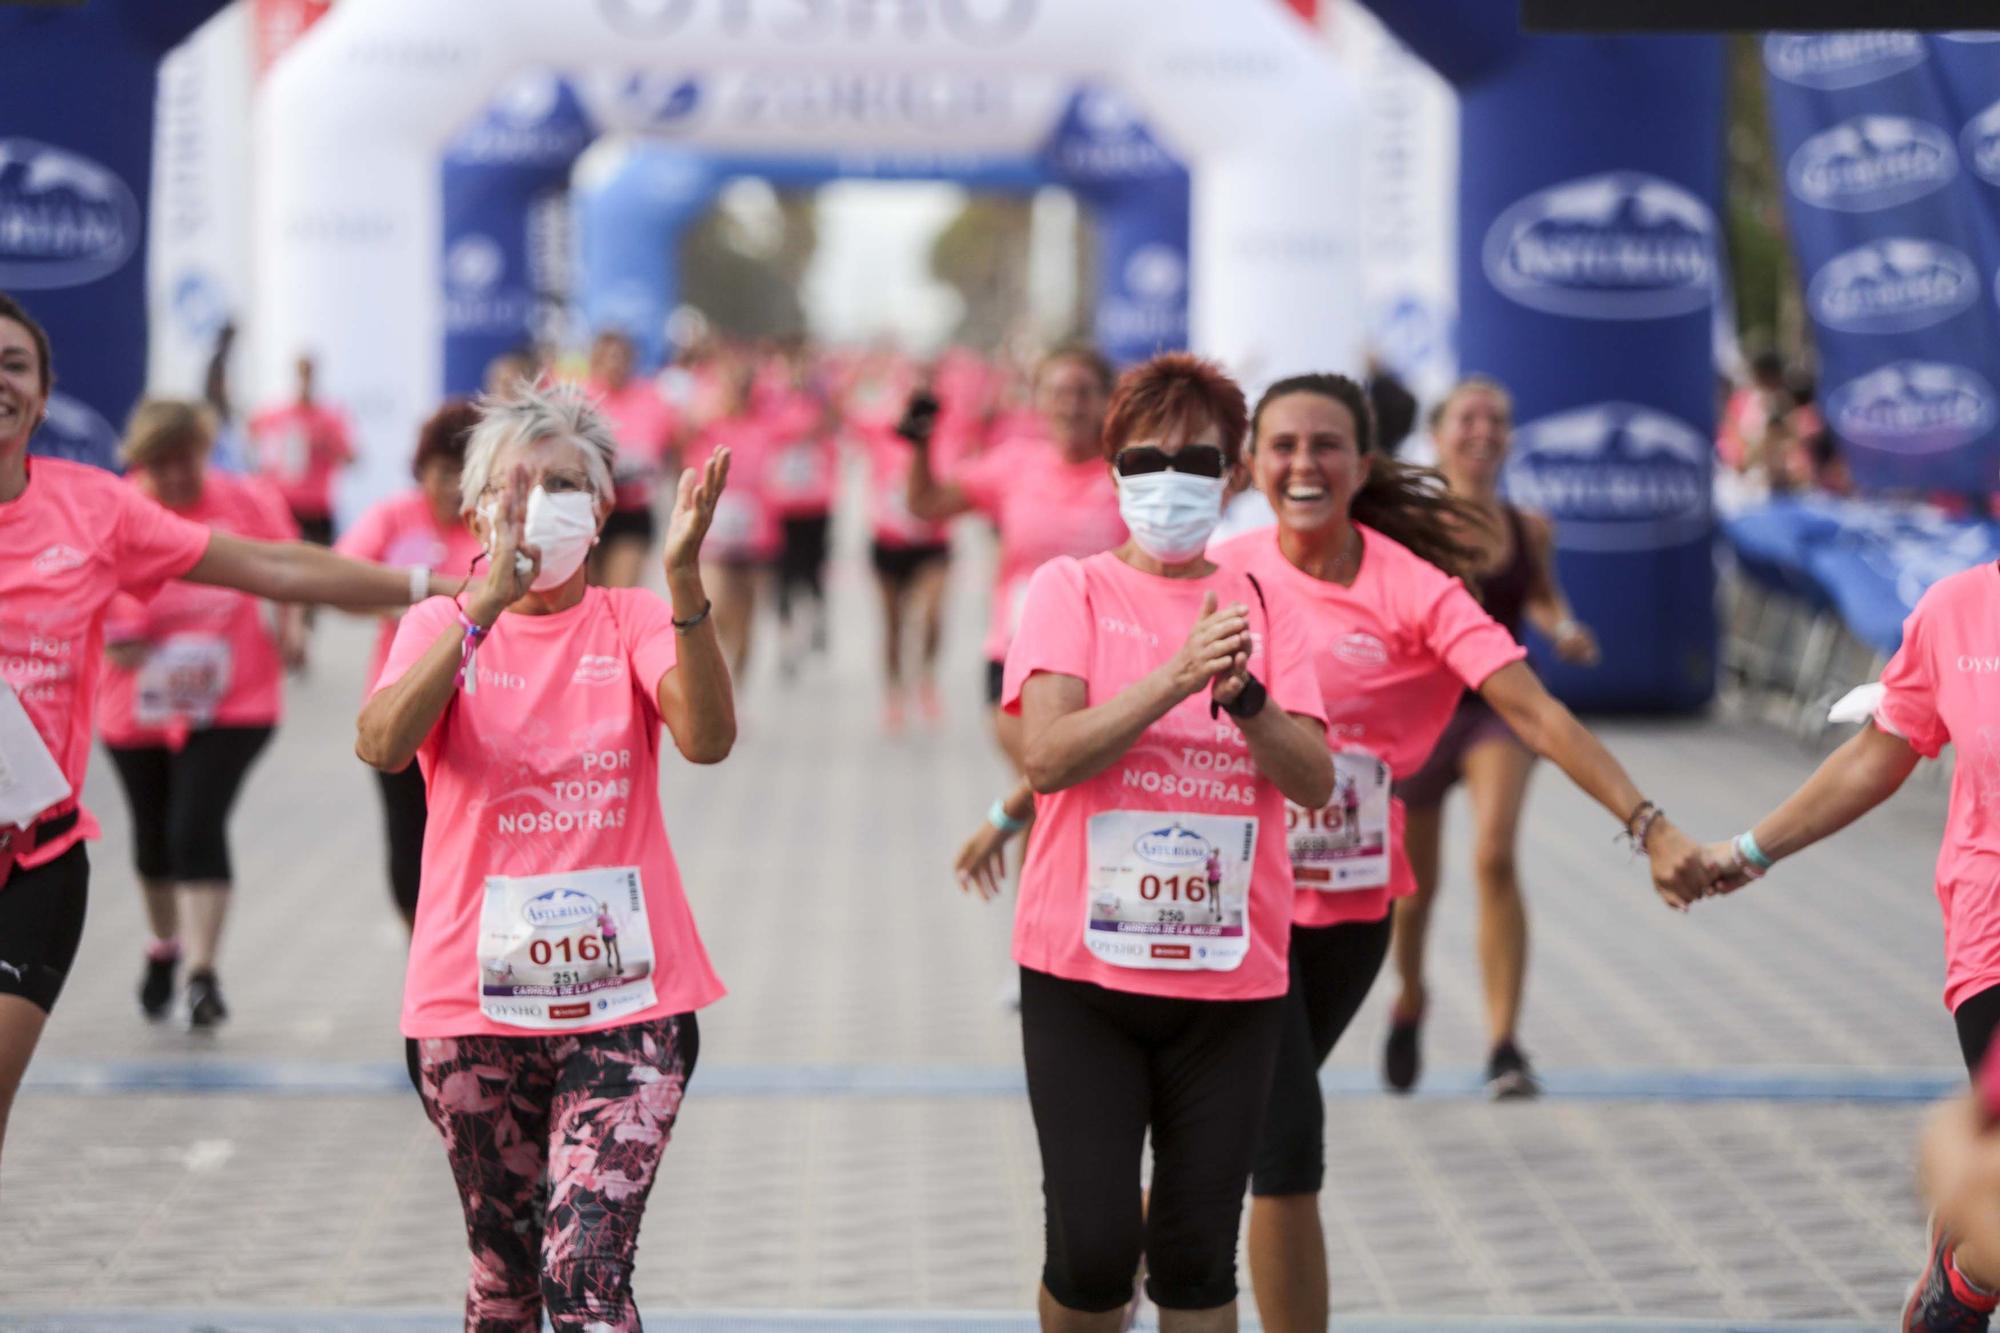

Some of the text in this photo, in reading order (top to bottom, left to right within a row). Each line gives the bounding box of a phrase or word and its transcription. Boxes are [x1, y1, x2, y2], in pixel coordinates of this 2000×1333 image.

[1215, 724, 1248, 747] PO
[582, 750, 631, 772] POR
[552, 778, 631, 801] TODAS
[1122, 768, 1257, 806] NOSOTRAS
[498, 808, 627, 834] NOSOTRAS
[1139, 875, 1206, 902] 016
[529, 935, 602, 965] 016
[552, 971, 580, 985] 251
[511, 985, 558, 997] CARRERA
[560, 986, 574, 995] DE
[575, 984, 589, 995] LA
[487, 1003, 543, 1018] OYSHO
